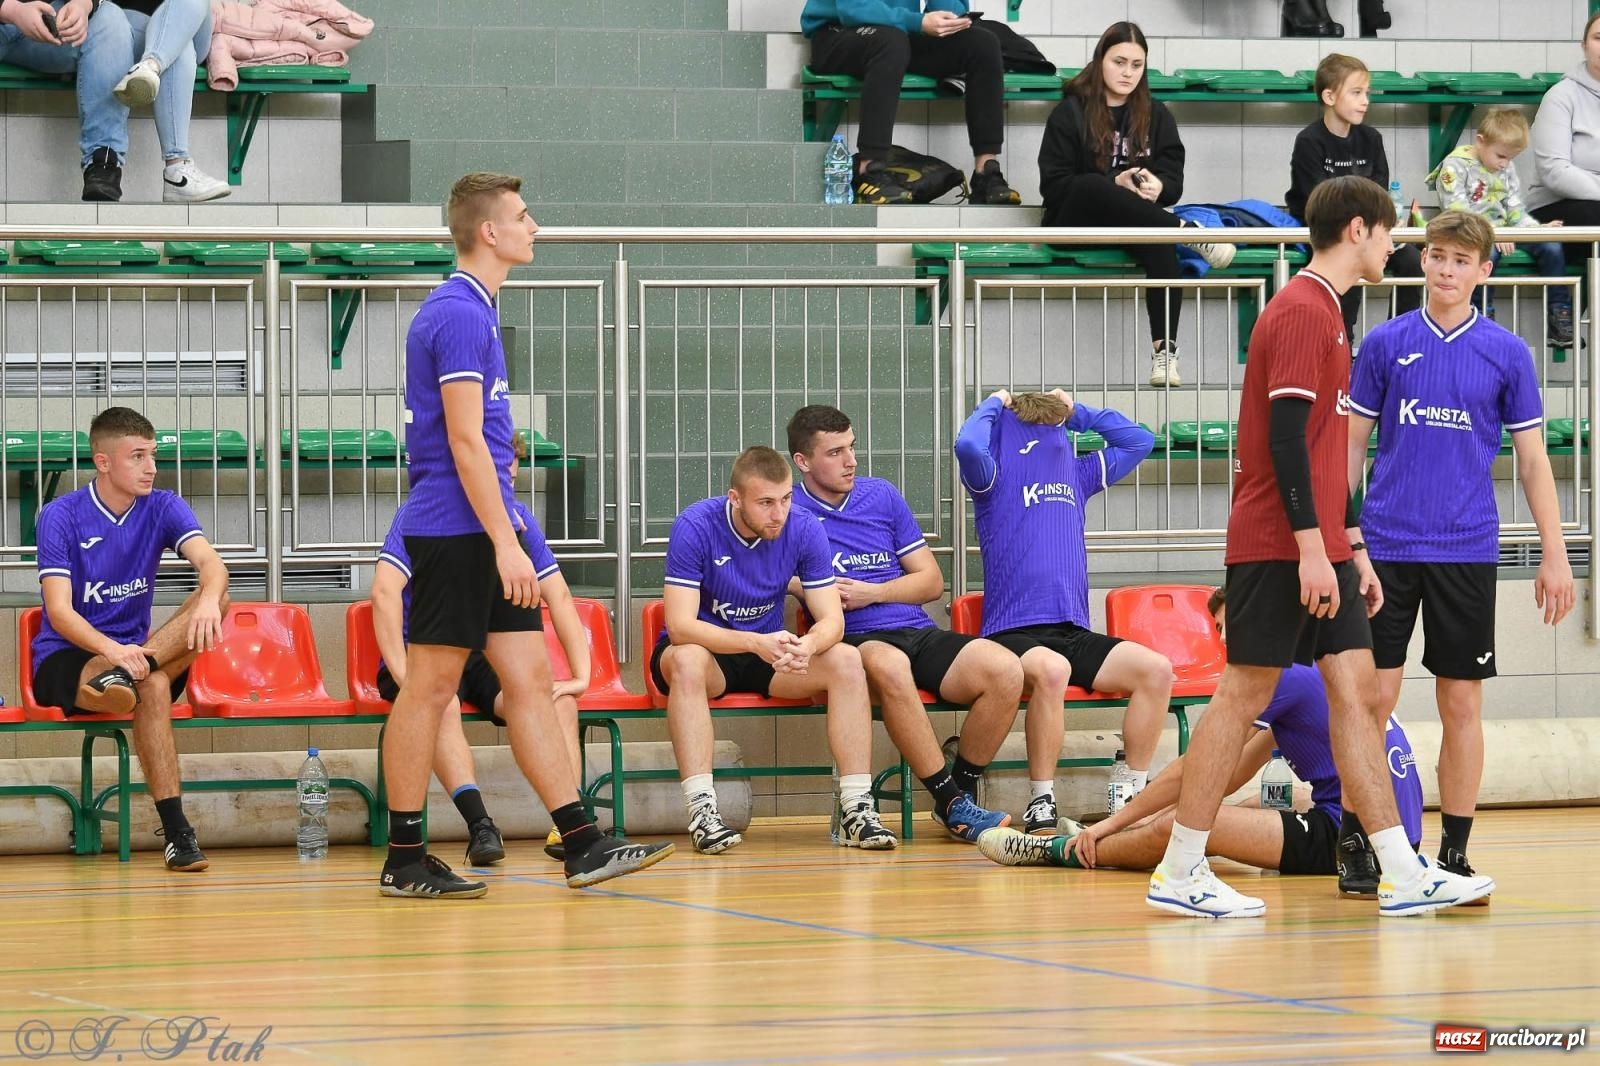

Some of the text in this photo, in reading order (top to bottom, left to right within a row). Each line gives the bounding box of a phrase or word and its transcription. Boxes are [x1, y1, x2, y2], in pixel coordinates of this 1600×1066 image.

[83, 577, 149, 604] K-INSTAL
[711, 598, 776, 621] K-INSTAL
[384, 873, 394, 884] 23
